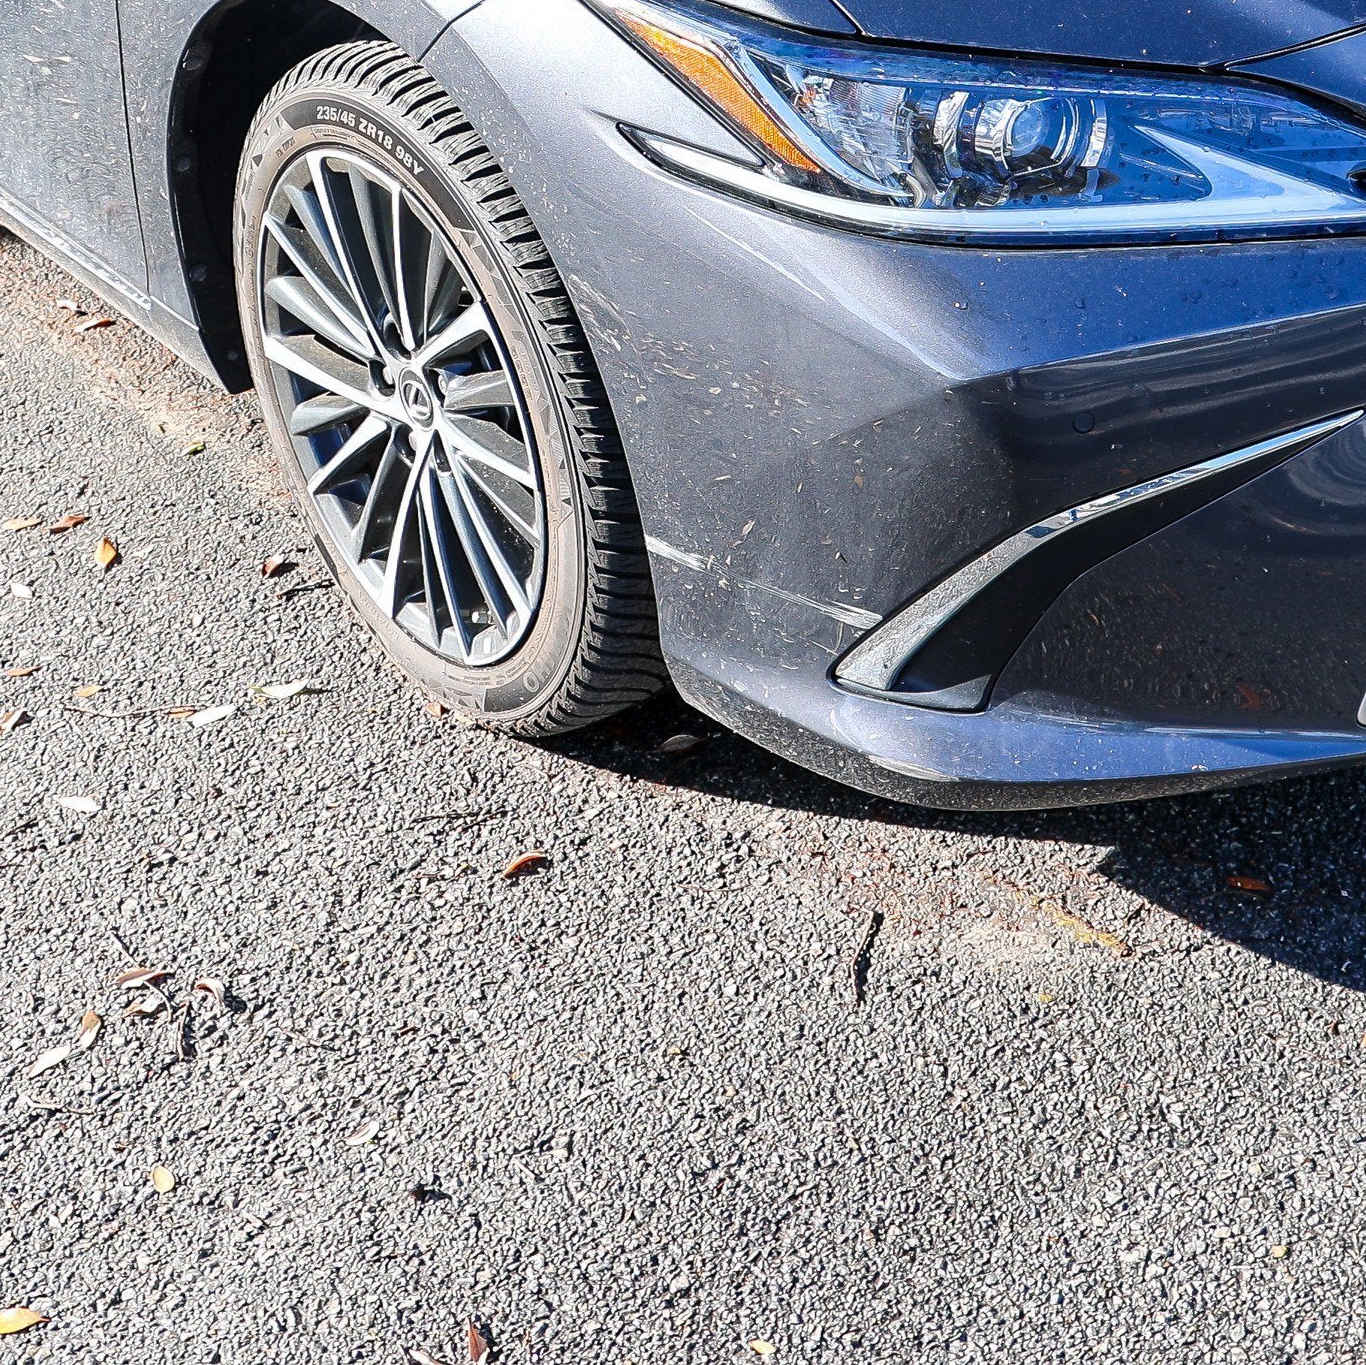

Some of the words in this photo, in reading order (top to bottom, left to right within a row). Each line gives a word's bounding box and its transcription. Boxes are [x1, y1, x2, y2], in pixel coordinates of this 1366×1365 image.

[316, 105, 355, 126] 235/45
[359, 118, 393, 149] ZR18
[395, 146, 424, 175] 98Y
